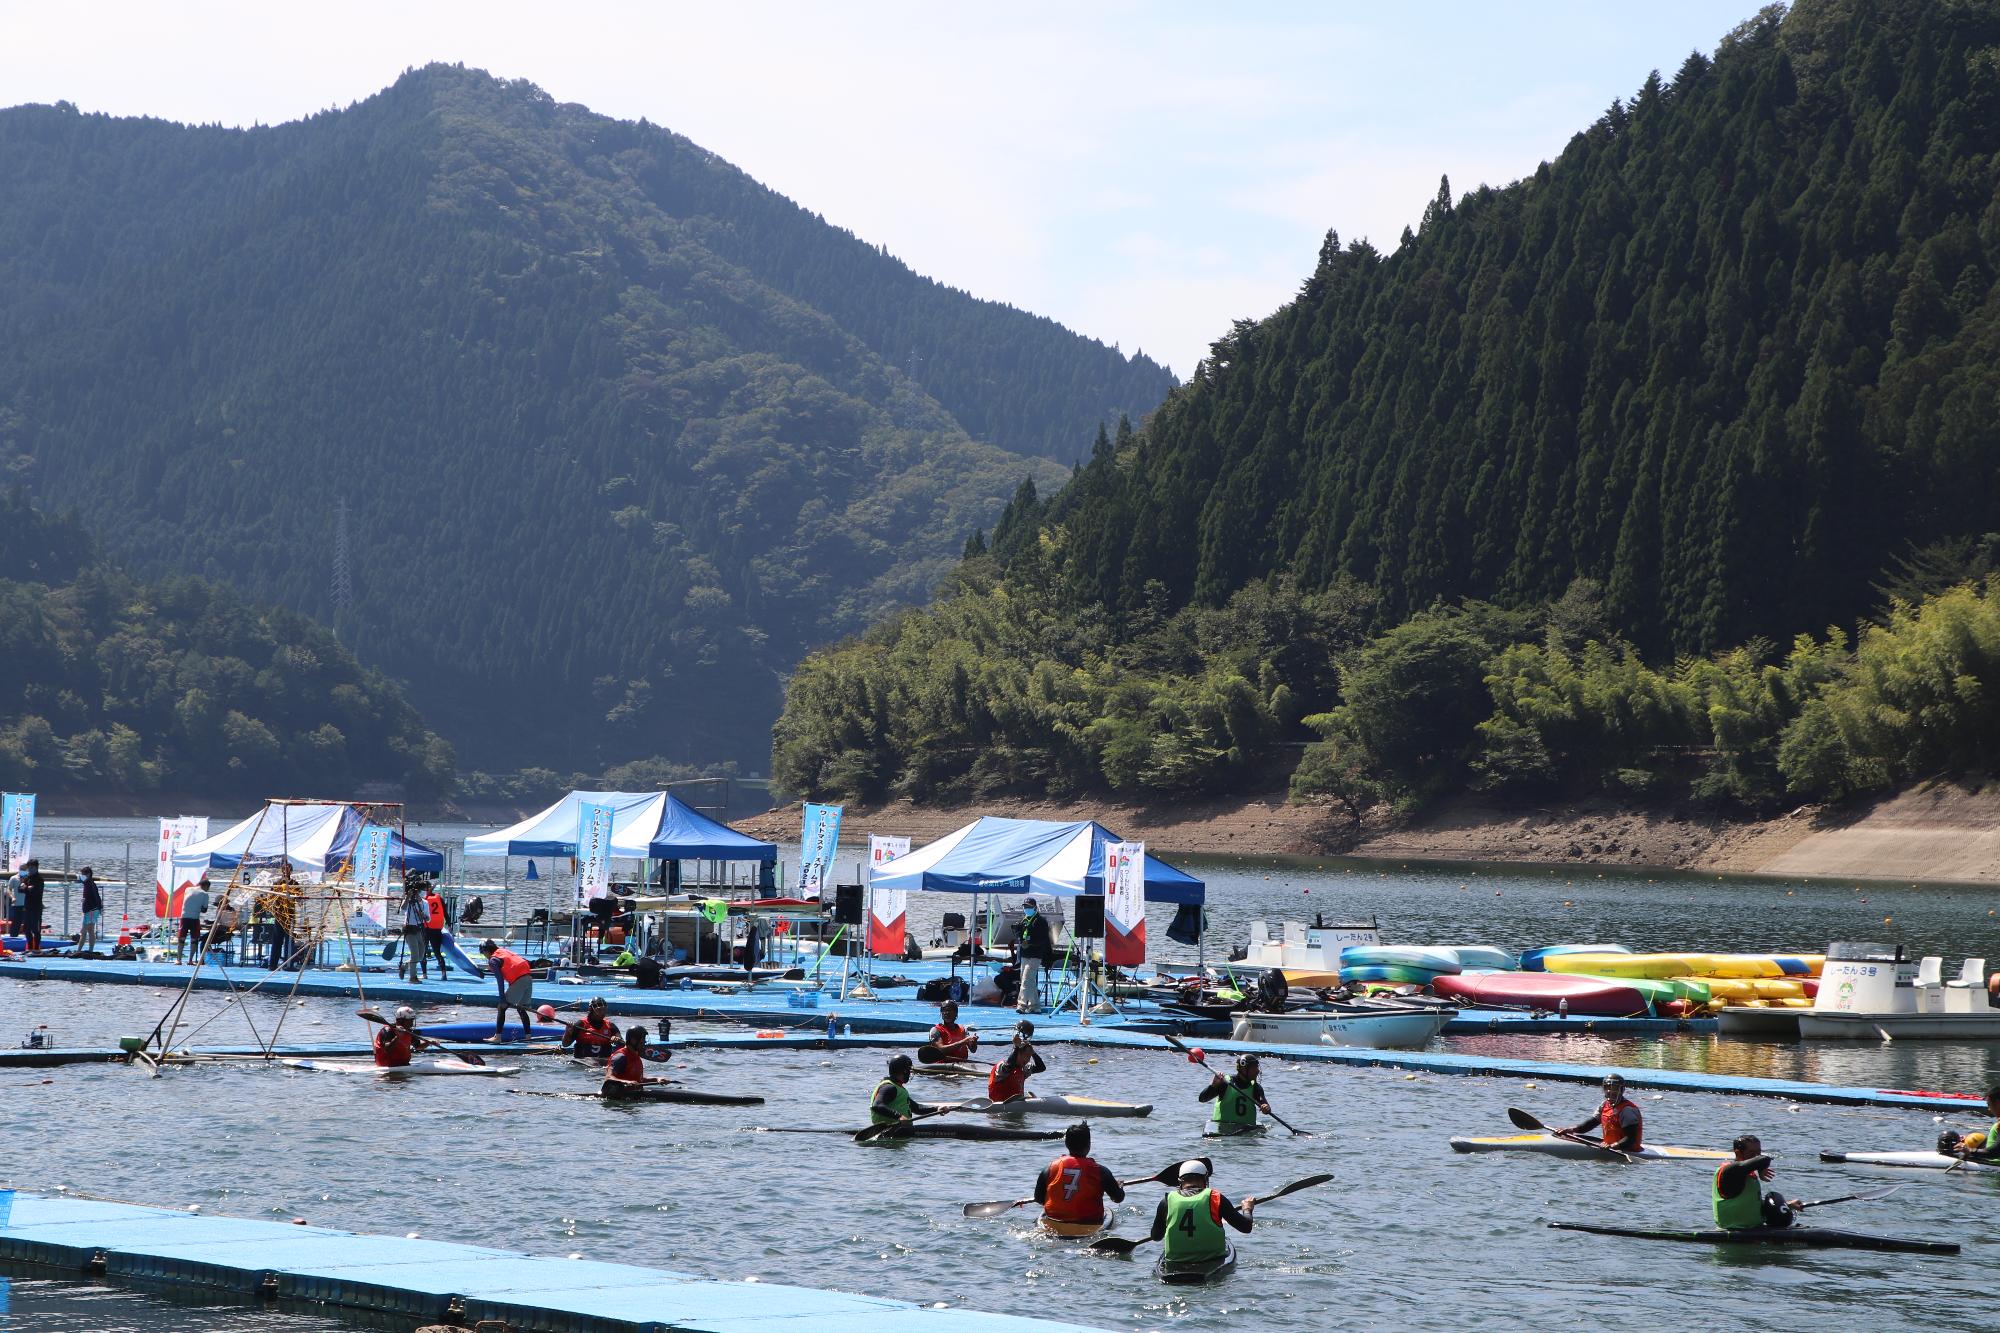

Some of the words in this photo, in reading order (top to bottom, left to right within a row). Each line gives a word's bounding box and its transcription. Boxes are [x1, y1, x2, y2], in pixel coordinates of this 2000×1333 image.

[243, 871, 252, 886] B
[431, 901, 440, 915] 2
[1235, 1095, 1247, 1117] 6
[1063, 1168, 1081, 1201] 7
[1178, 1208, 1197, 1238] 4
